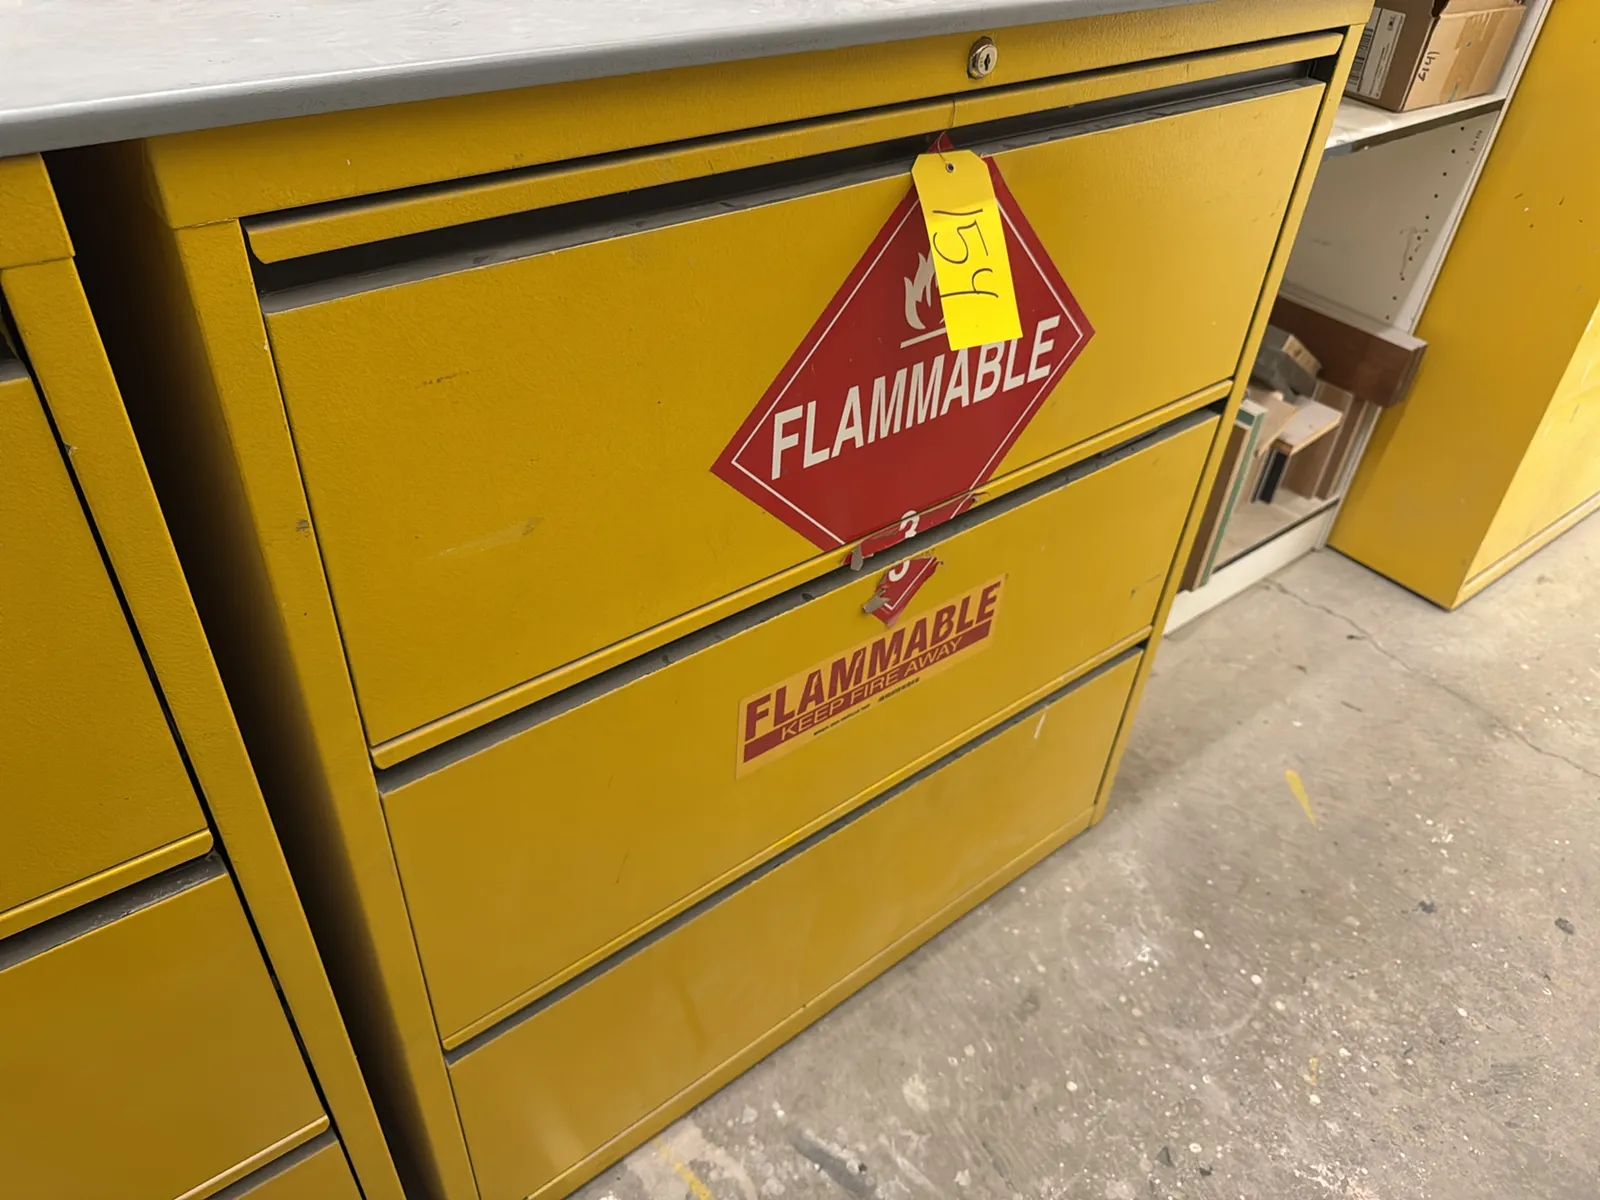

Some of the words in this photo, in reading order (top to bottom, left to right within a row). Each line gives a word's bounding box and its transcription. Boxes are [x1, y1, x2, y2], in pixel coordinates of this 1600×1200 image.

[932, 208, 999, 299] 154
[771, 314, 1061, 481] FLAMMABLE
[744, 580, 1002, 742] FLAMMABLE
[781, 697, 844, 741] KEEP
[850, 667, 900, 702] FIRE
[904, 636, 964, 677] AWAY
